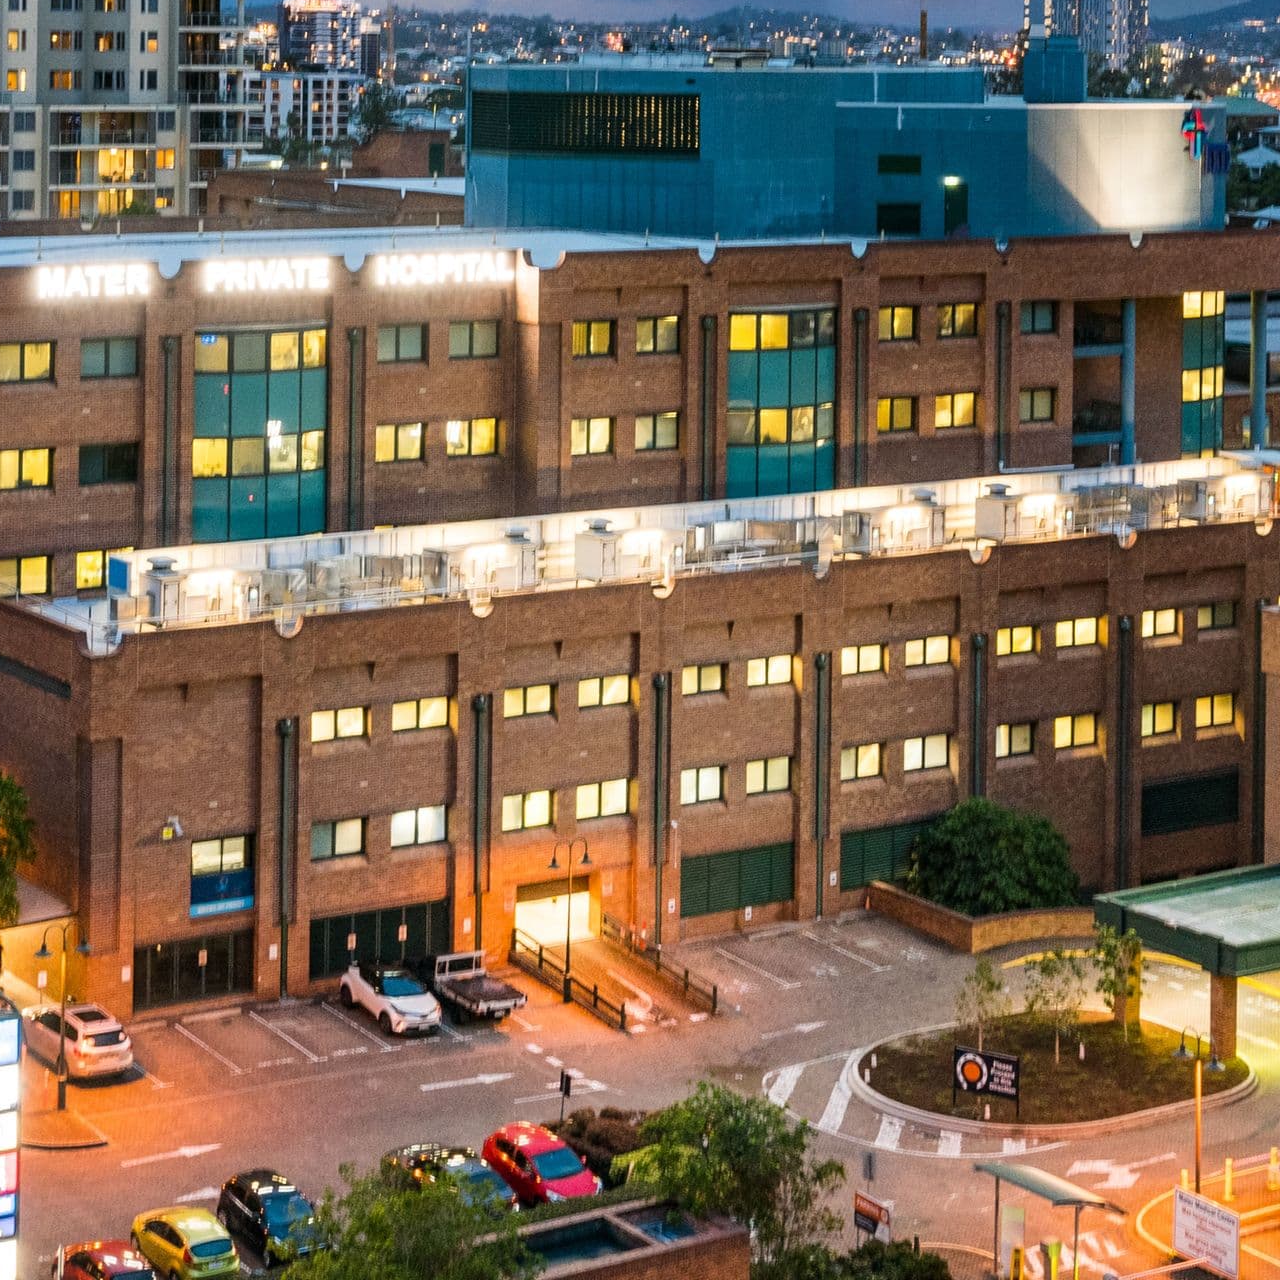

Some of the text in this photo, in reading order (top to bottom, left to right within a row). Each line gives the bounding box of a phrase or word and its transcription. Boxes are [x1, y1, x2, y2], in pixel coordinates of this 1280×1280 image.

[38, 251, 515, 297] MATER PRIVATE HOSPITAL
